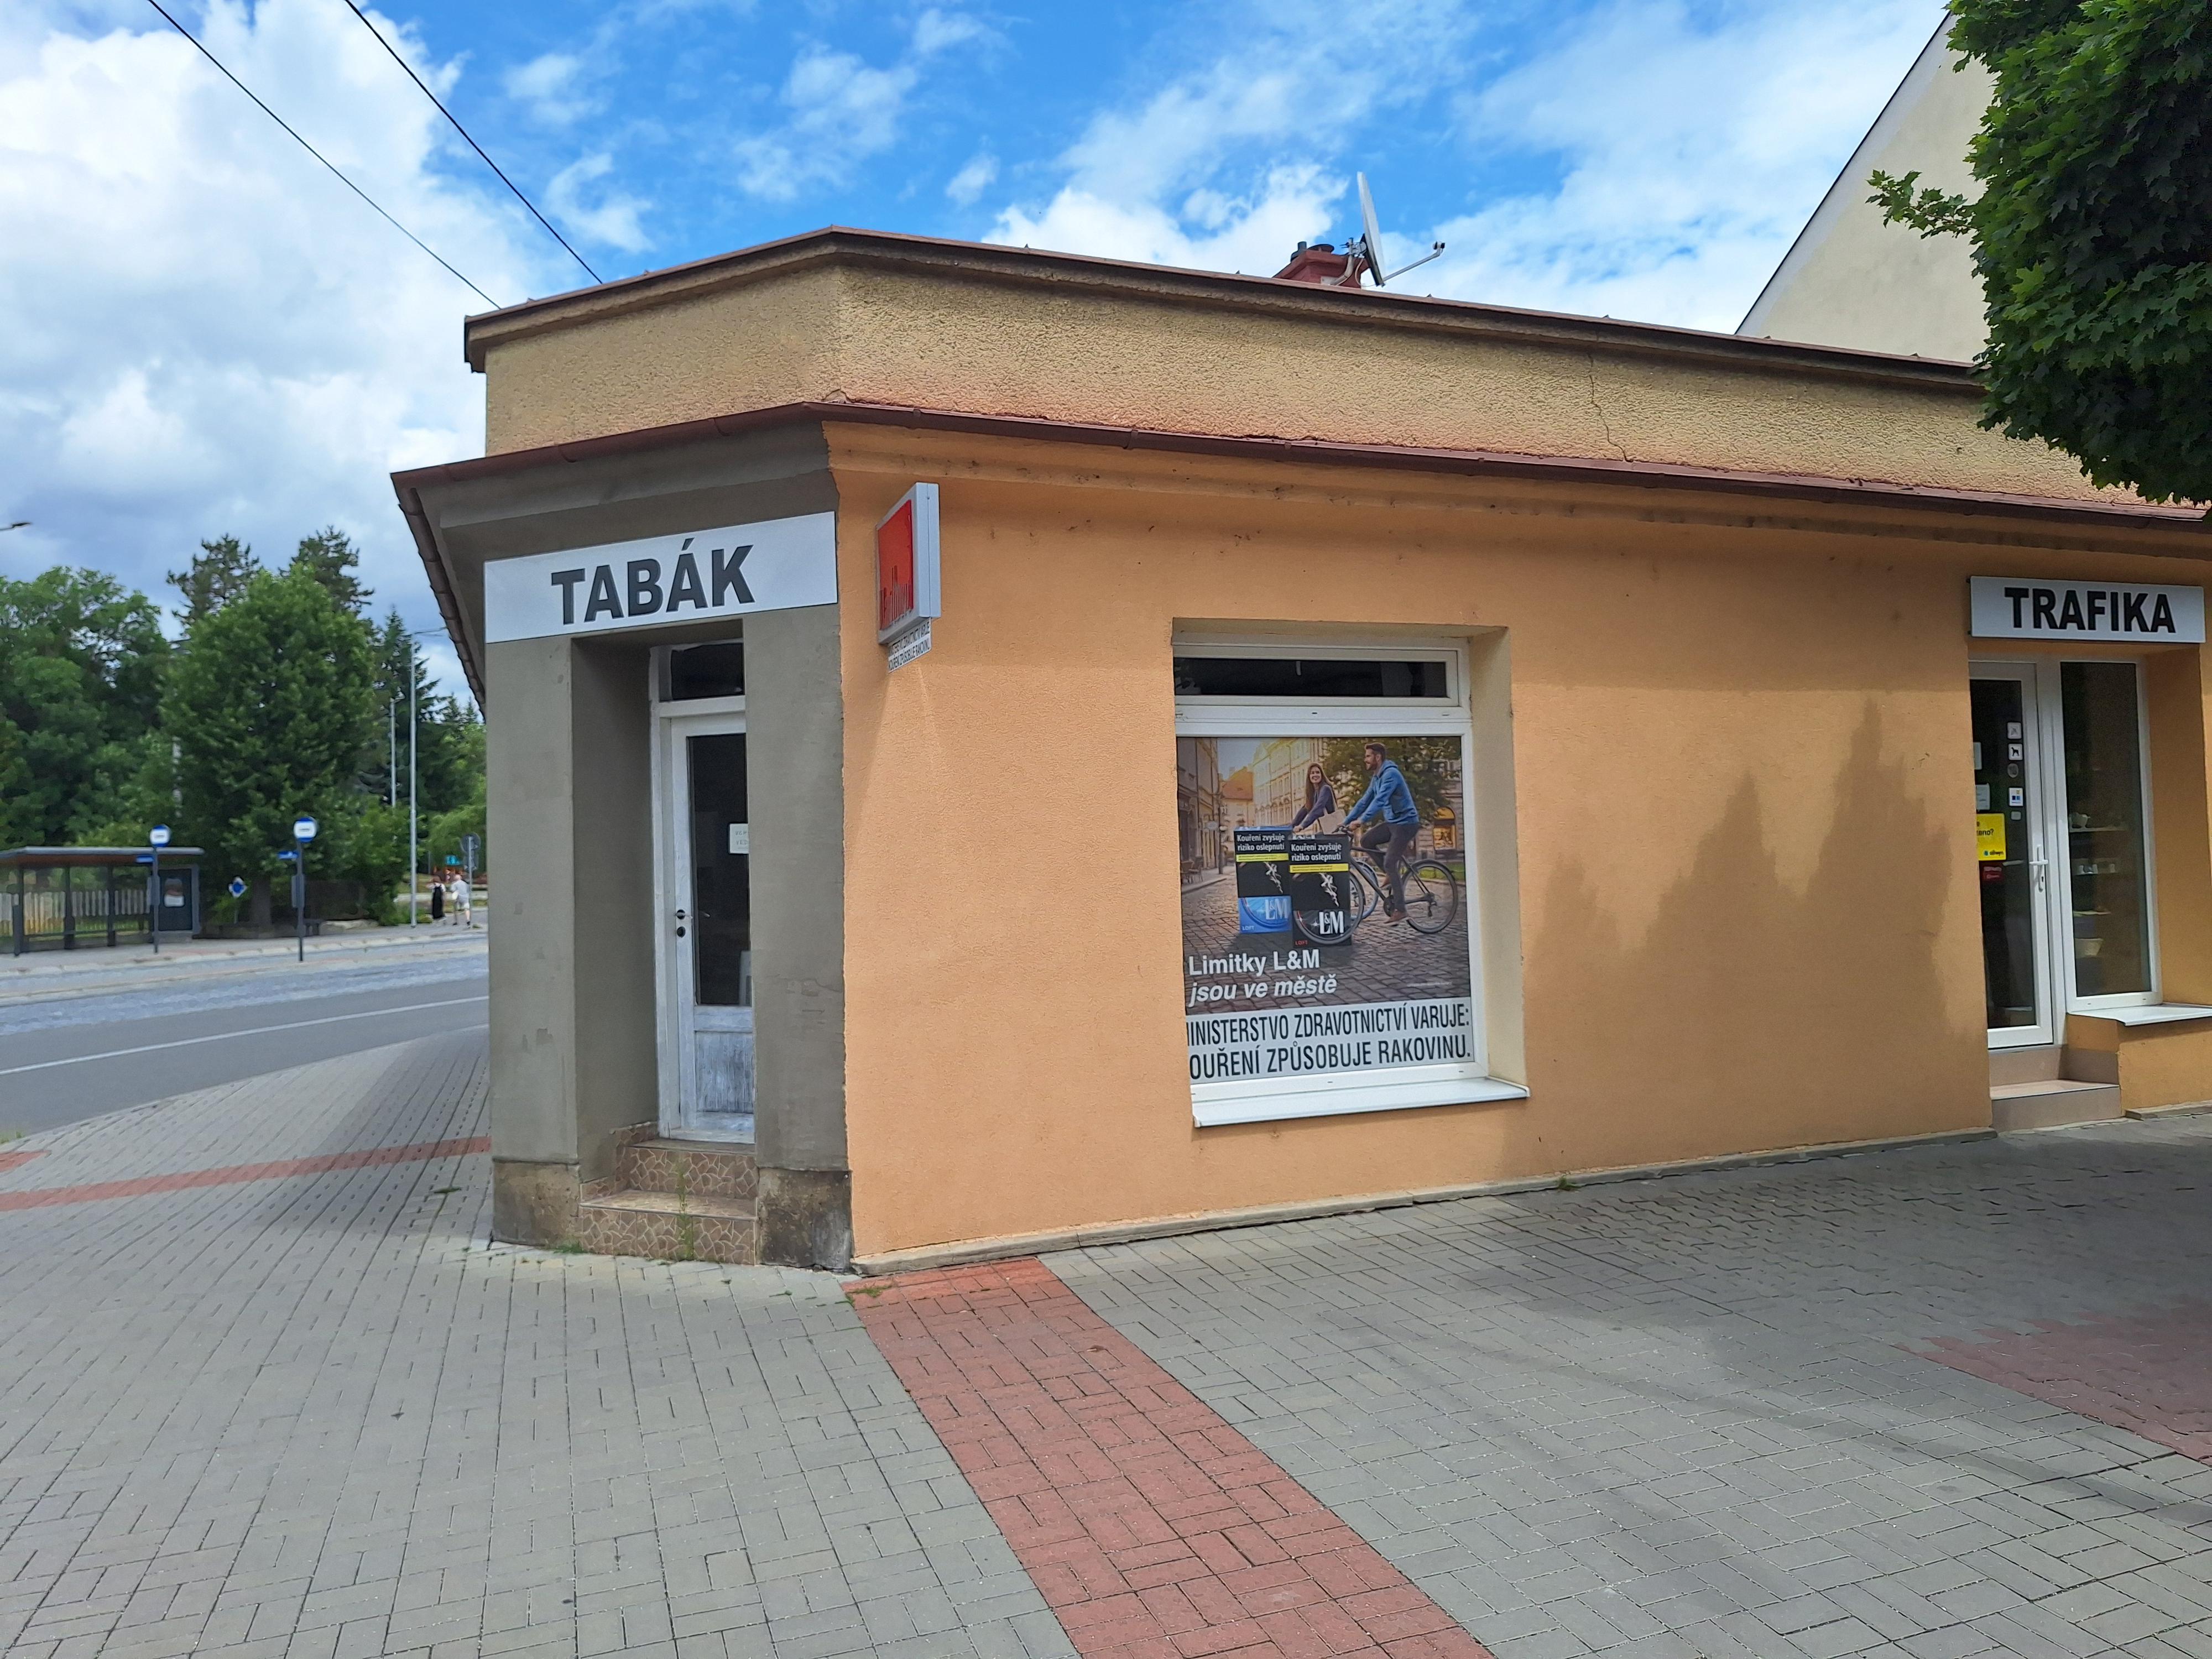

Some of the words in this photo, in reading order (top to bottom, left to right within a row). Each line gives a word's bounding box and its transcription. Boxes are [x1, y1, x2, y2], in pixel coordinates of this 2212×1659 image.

[551, 538, 755, 625] TABÁK
[2004, 587, 2176, 633] TRAFIKA
[1262, 833, 1285, 843] zvyšuje
[1291, 843, 1317, 852] Kouření
[1317, 842, 1342, 852] zvyšuje
[1265, 898, 1288, 920] L&M
[1318, 910, 1344, 935] L&M
[1188, 953, 1267, 977] Limitky
[1273, 948, 1320, 971] L&M
[1188, 982, 1238, 1008] jsou
[1244, 982, 1268, 998] ve
[1274, 973, 1337, 996] městě
[1186, 1015, 1289, 1046] INISTERSTVO
[1294, 1003, 1407, 1038] ZDRAVOTNICTVÍ
[1410, 1003, 1469, 1029] VARUJE:
[1190, 1045, 1261, 1079] OUŘENÍ
[1266, 1041, 1372, 1073] ZPŮSOBUJE
[1378, 1034, 1470, 1063] RAKOVINU.
